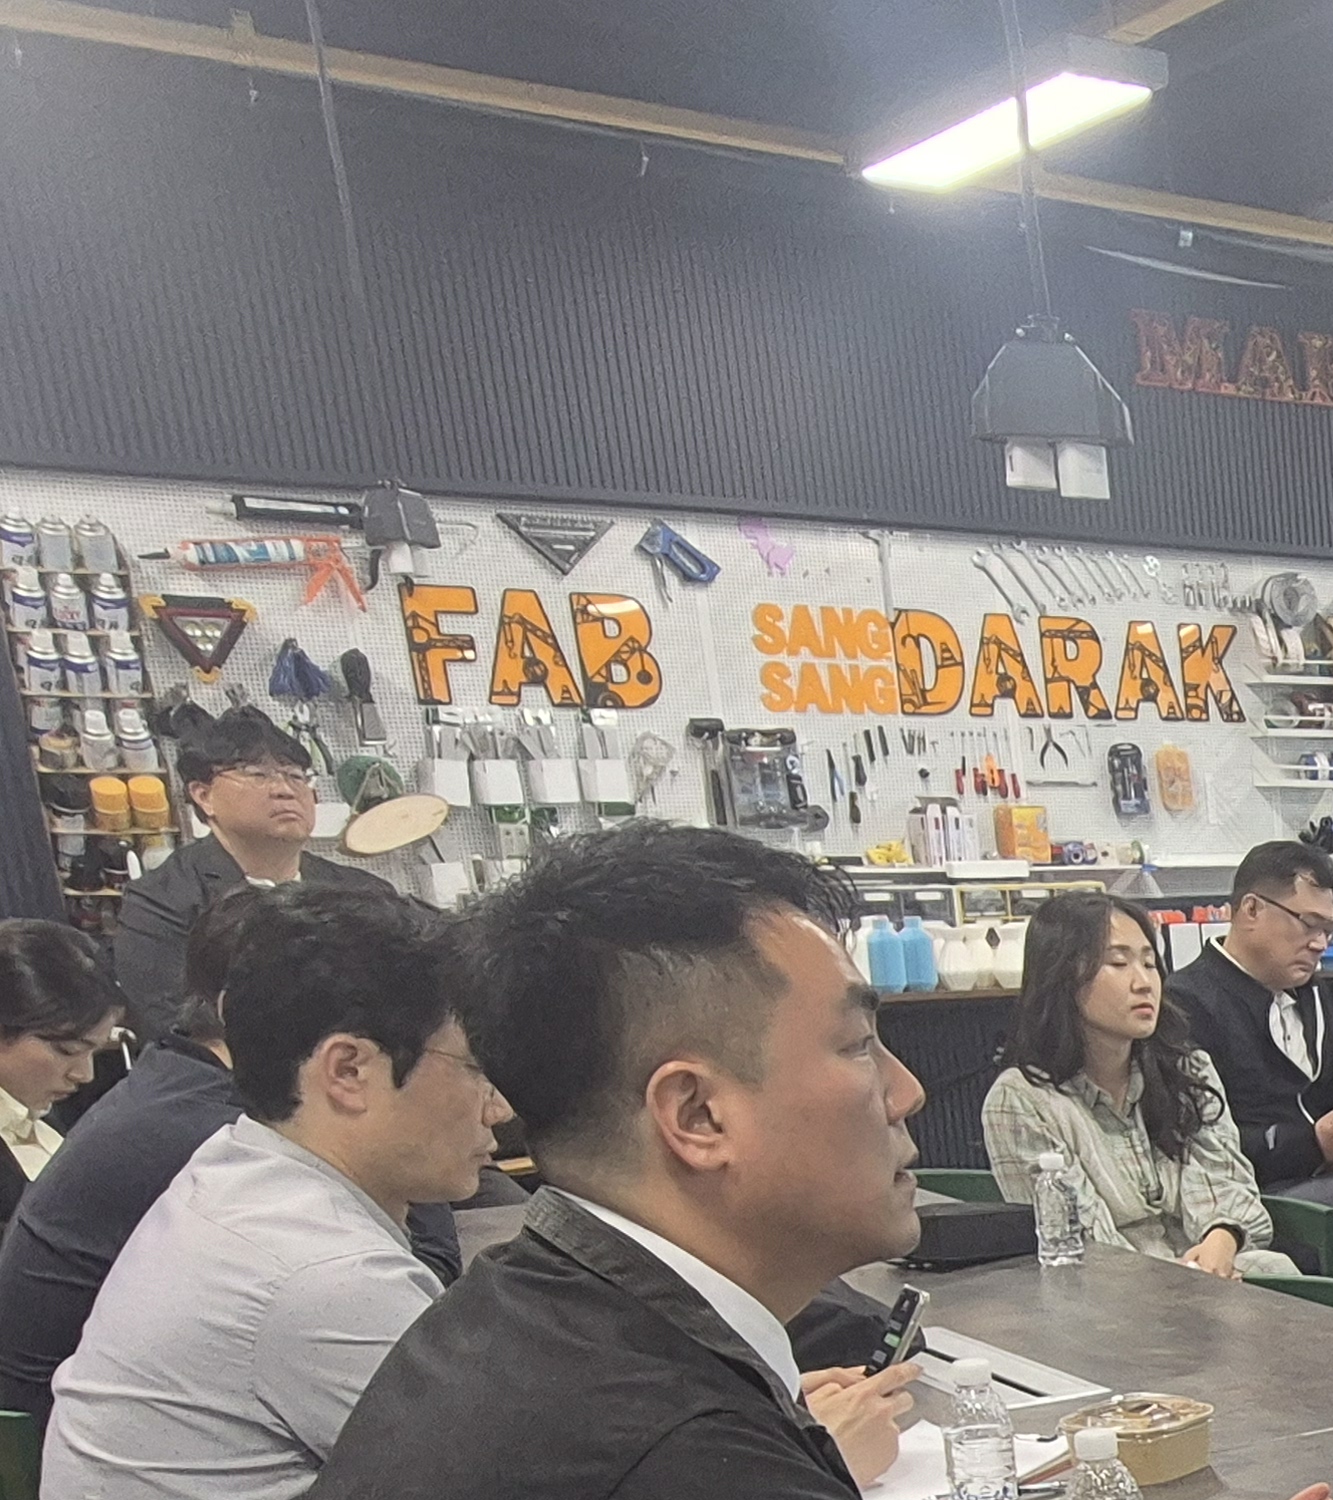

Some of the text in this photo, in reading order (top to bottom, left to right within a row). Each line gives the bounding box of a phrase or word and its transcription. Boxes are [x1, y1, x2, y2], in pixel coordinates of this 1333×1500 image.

[397, 583, 662, 708] FAB
[752, 603, 893, 660] SANG
[892, 609, 1246, 722] DARAK
[760, 661, 900, 715] SANG
